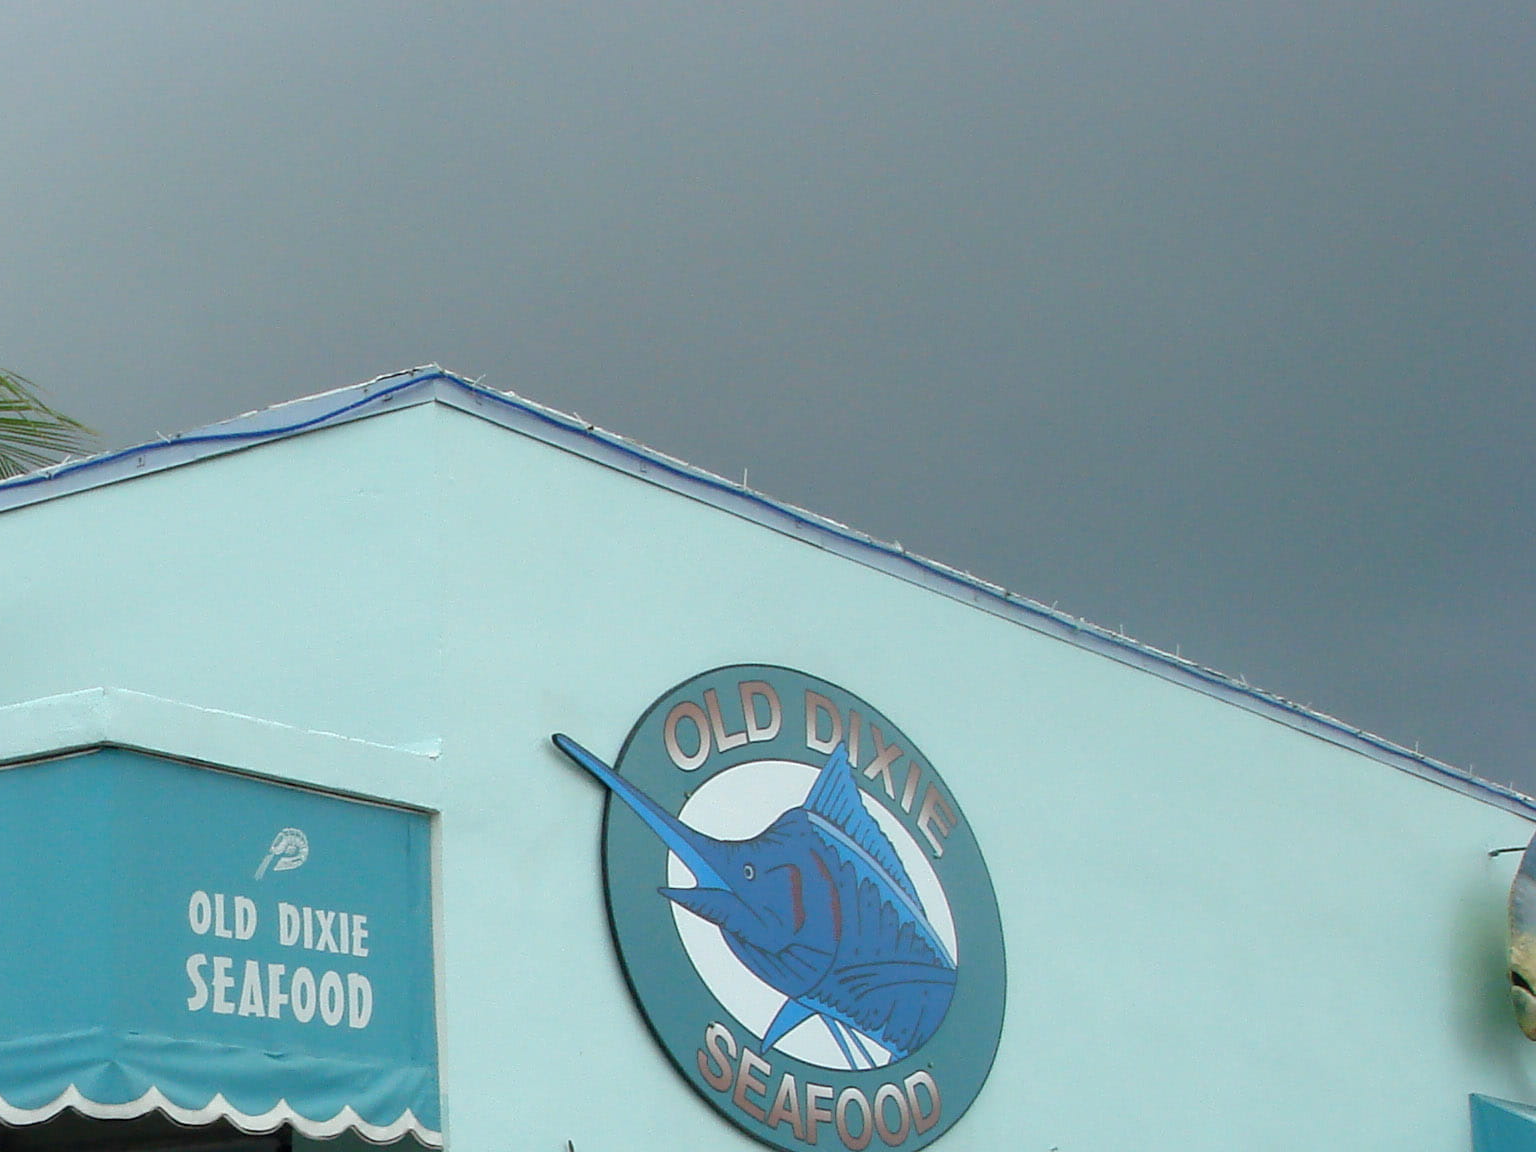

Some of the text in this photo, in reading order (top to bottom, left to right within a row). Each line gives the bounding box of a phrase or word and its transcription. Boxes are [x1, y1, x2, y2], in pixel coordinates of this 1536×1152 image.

[664, 680, 959, 859] OLD DIXIE
[188, 890, 369, 957] OLD DIXIE
[186, 953, 373, 1029] SEAFOOD
[697, 1020, 943, 1152] SEAFOOD
